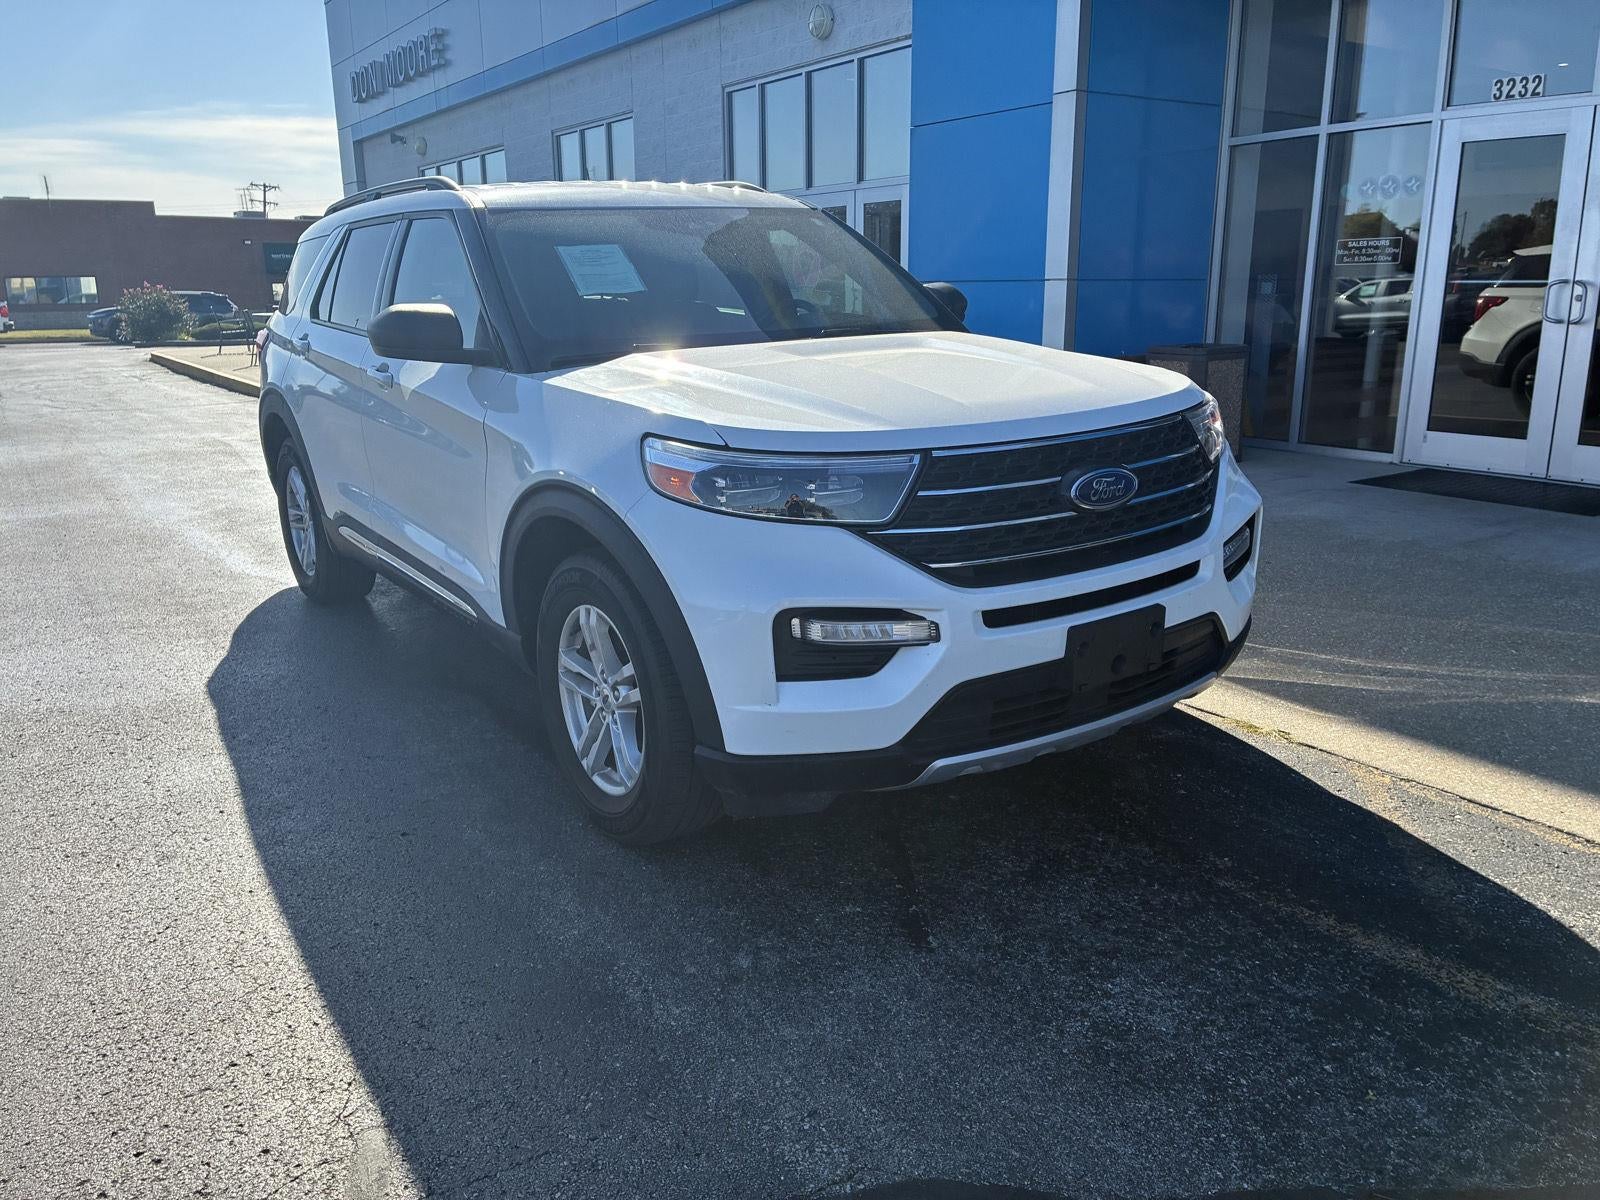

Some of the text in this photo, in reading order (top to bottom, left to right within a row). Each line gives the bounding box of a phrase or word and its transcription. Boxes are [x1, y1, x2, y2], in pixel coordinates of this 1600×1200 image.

[350, 27, 446, 103] DON MOORE
[1493, 74, 1543, 101] 3232
[1368, 239, 1390, 247] HOURS
[1090, 477, 1126, 501] Ford
